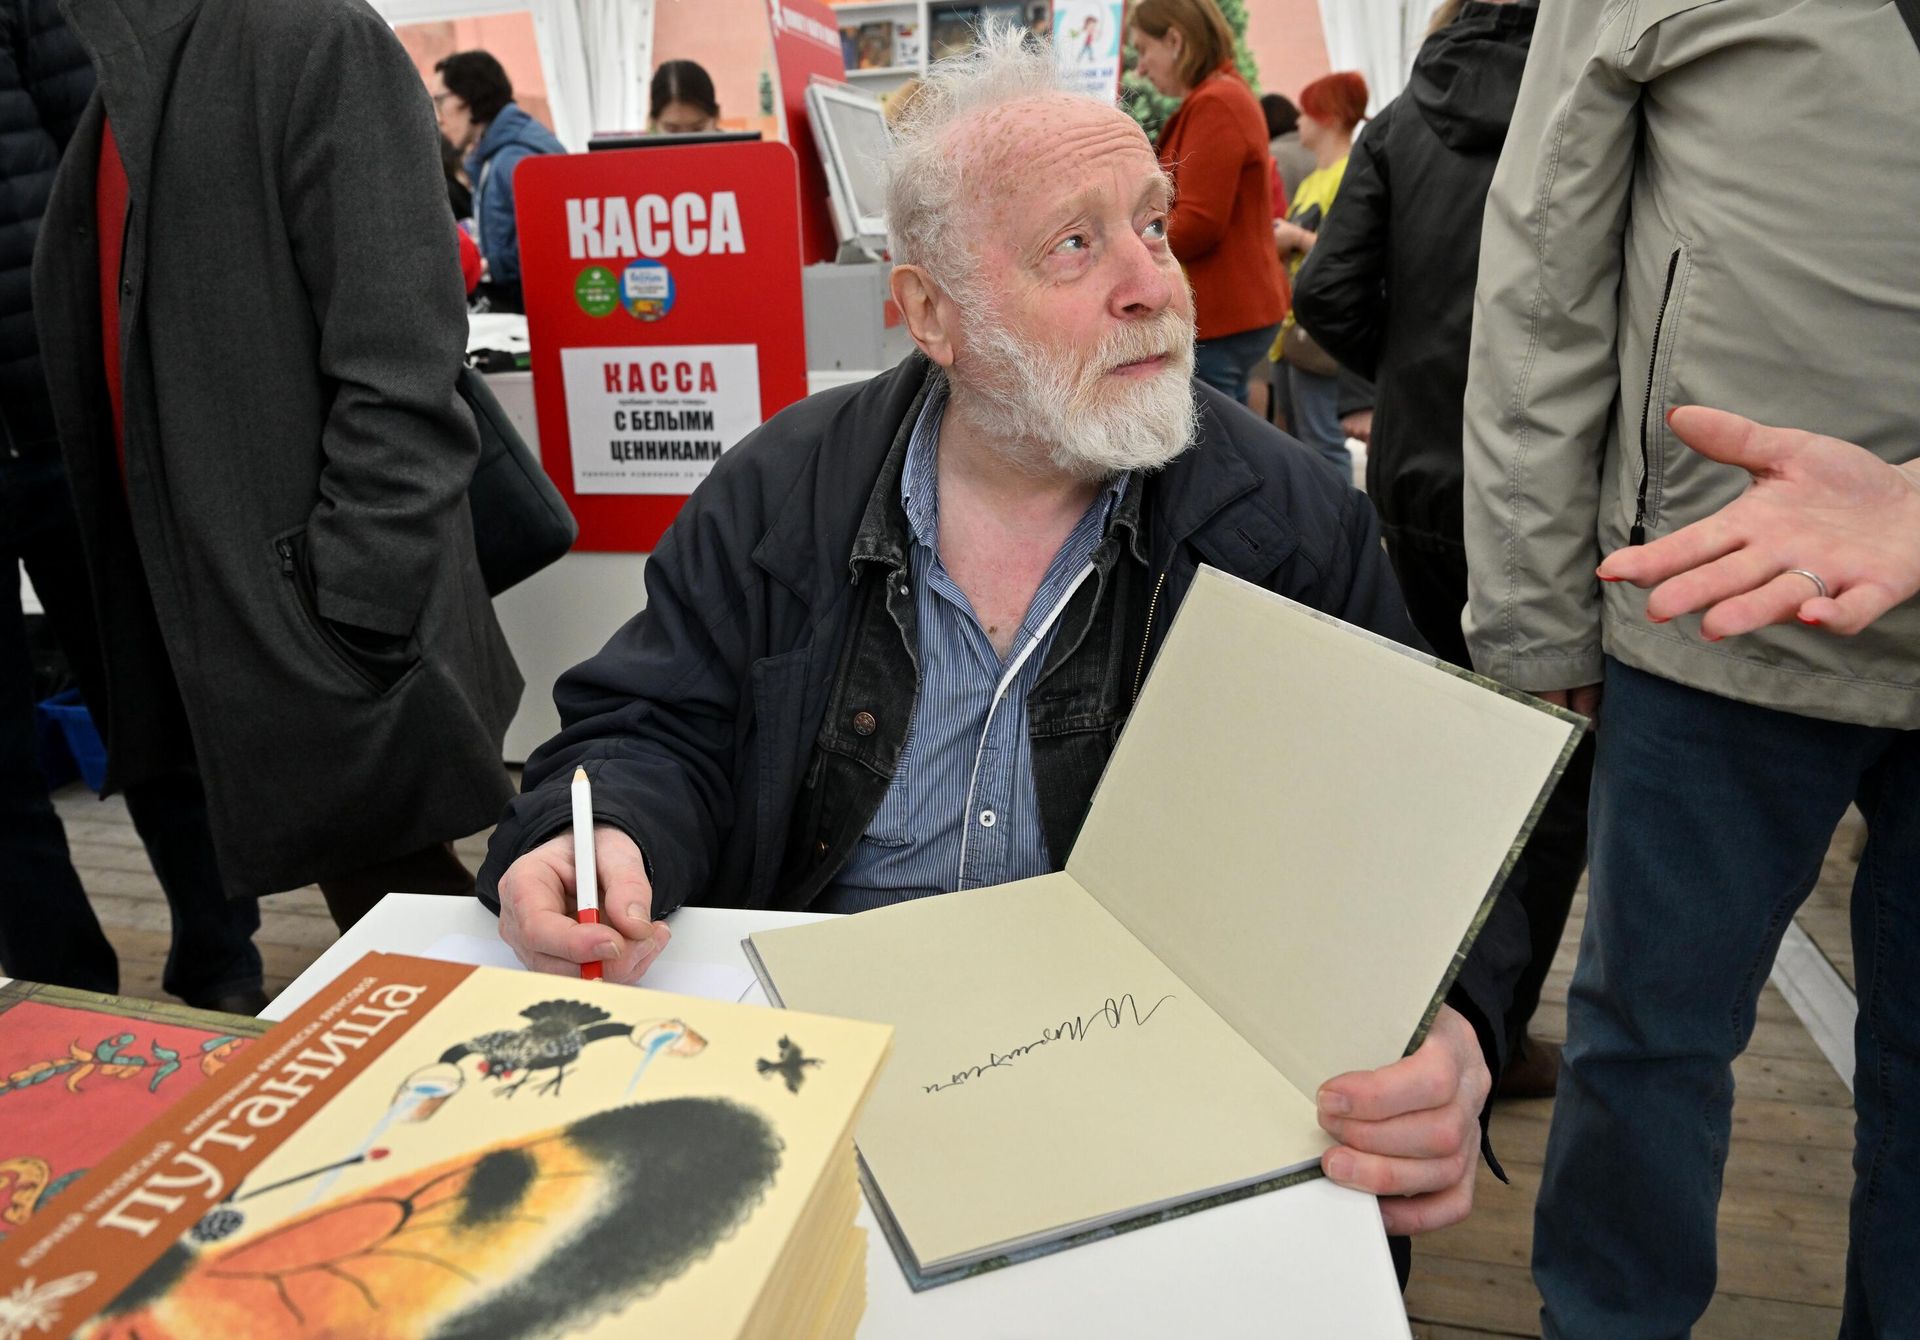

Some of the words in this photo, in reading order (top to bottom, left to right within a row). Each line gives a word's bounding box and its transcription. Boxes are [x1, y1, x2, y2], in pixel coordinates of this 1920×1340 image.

[565, 191, 746, 260] КАССА
[604, 362, 717, 393] КАССА
[614, 411, 626, 431] С
[631, 411, 715, 431] БЕЛЫМИ
[610, 441, 722, 464] ЦЕННИКАМИ
